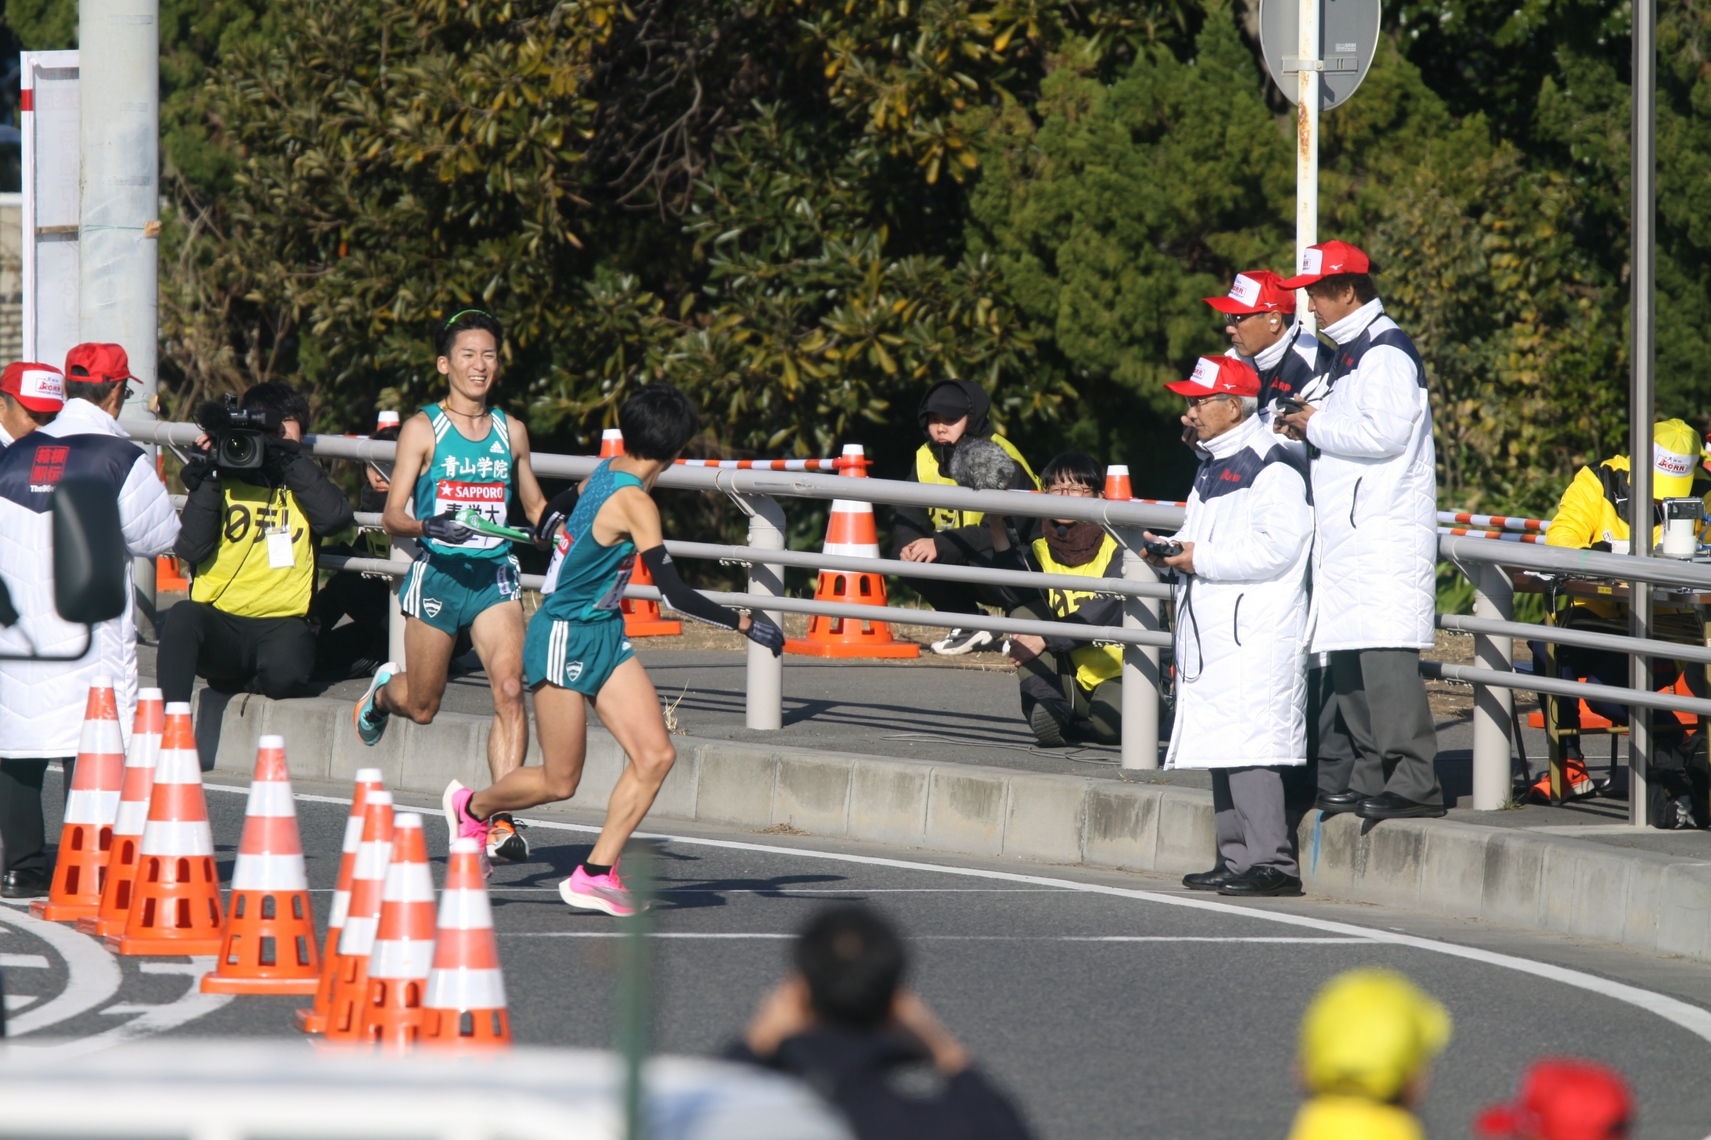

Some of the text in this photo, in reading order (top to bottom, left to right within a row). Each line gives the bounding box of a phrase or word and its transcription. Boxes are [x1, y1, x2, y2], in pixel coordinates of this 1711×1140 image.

[440, 454, 509, 479] 青山学院
[455, 486, 503, 499] SAPPORO
